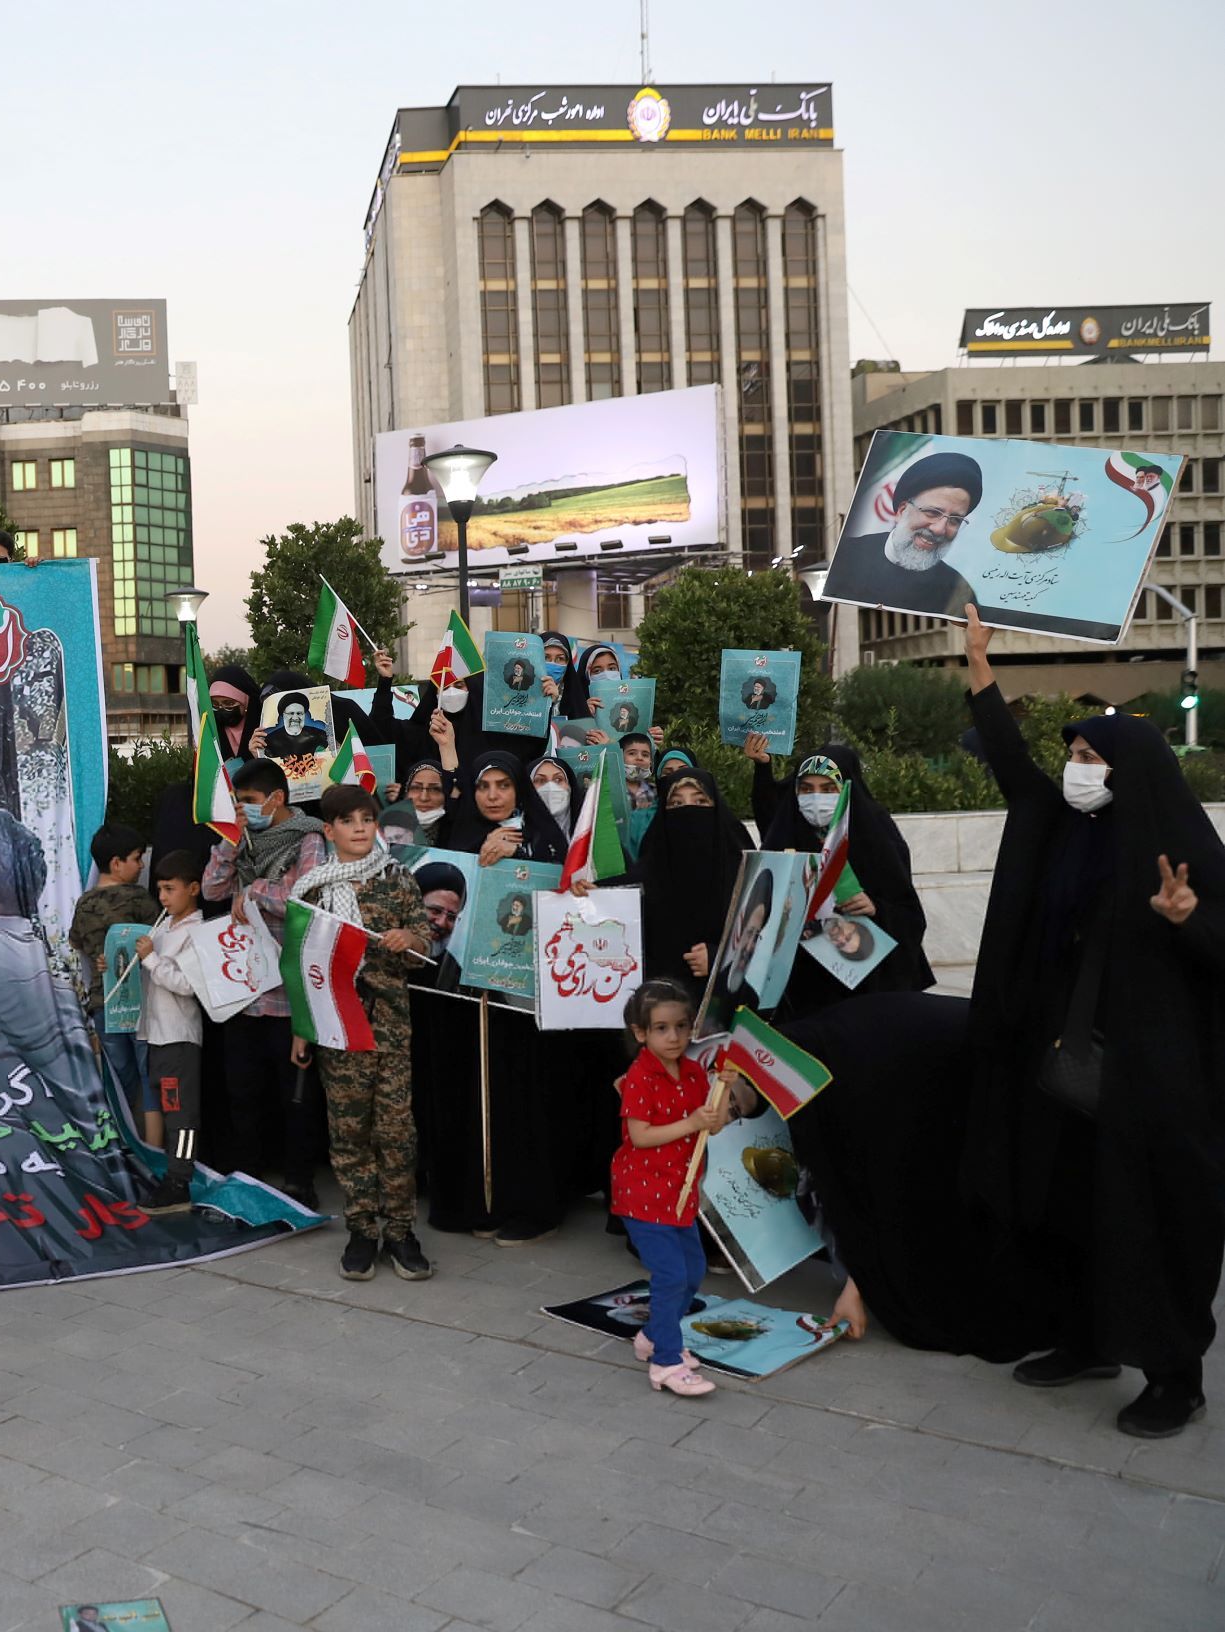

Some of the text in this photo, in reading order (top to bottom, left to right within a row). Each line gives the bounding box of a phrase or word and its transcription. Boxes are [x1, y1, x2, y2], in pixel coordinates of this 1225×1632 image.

[485, 98, 514, 126] تهران
[512, 90, 546, 126] مرکزی
[702, 98, 740, 125] ایران
[757, 86, 828, 128] بانک
[702, 128, 820, 141] BANK MELLI IRAN
[1120, 316, 1158, 337] ایران
[1168, 305, 1208, 335] بانک
[17, 379, 46, 392] ۴۰۰
[20, 1151, 65, 1177] به
[77, 1193, 151, 1240] کار
